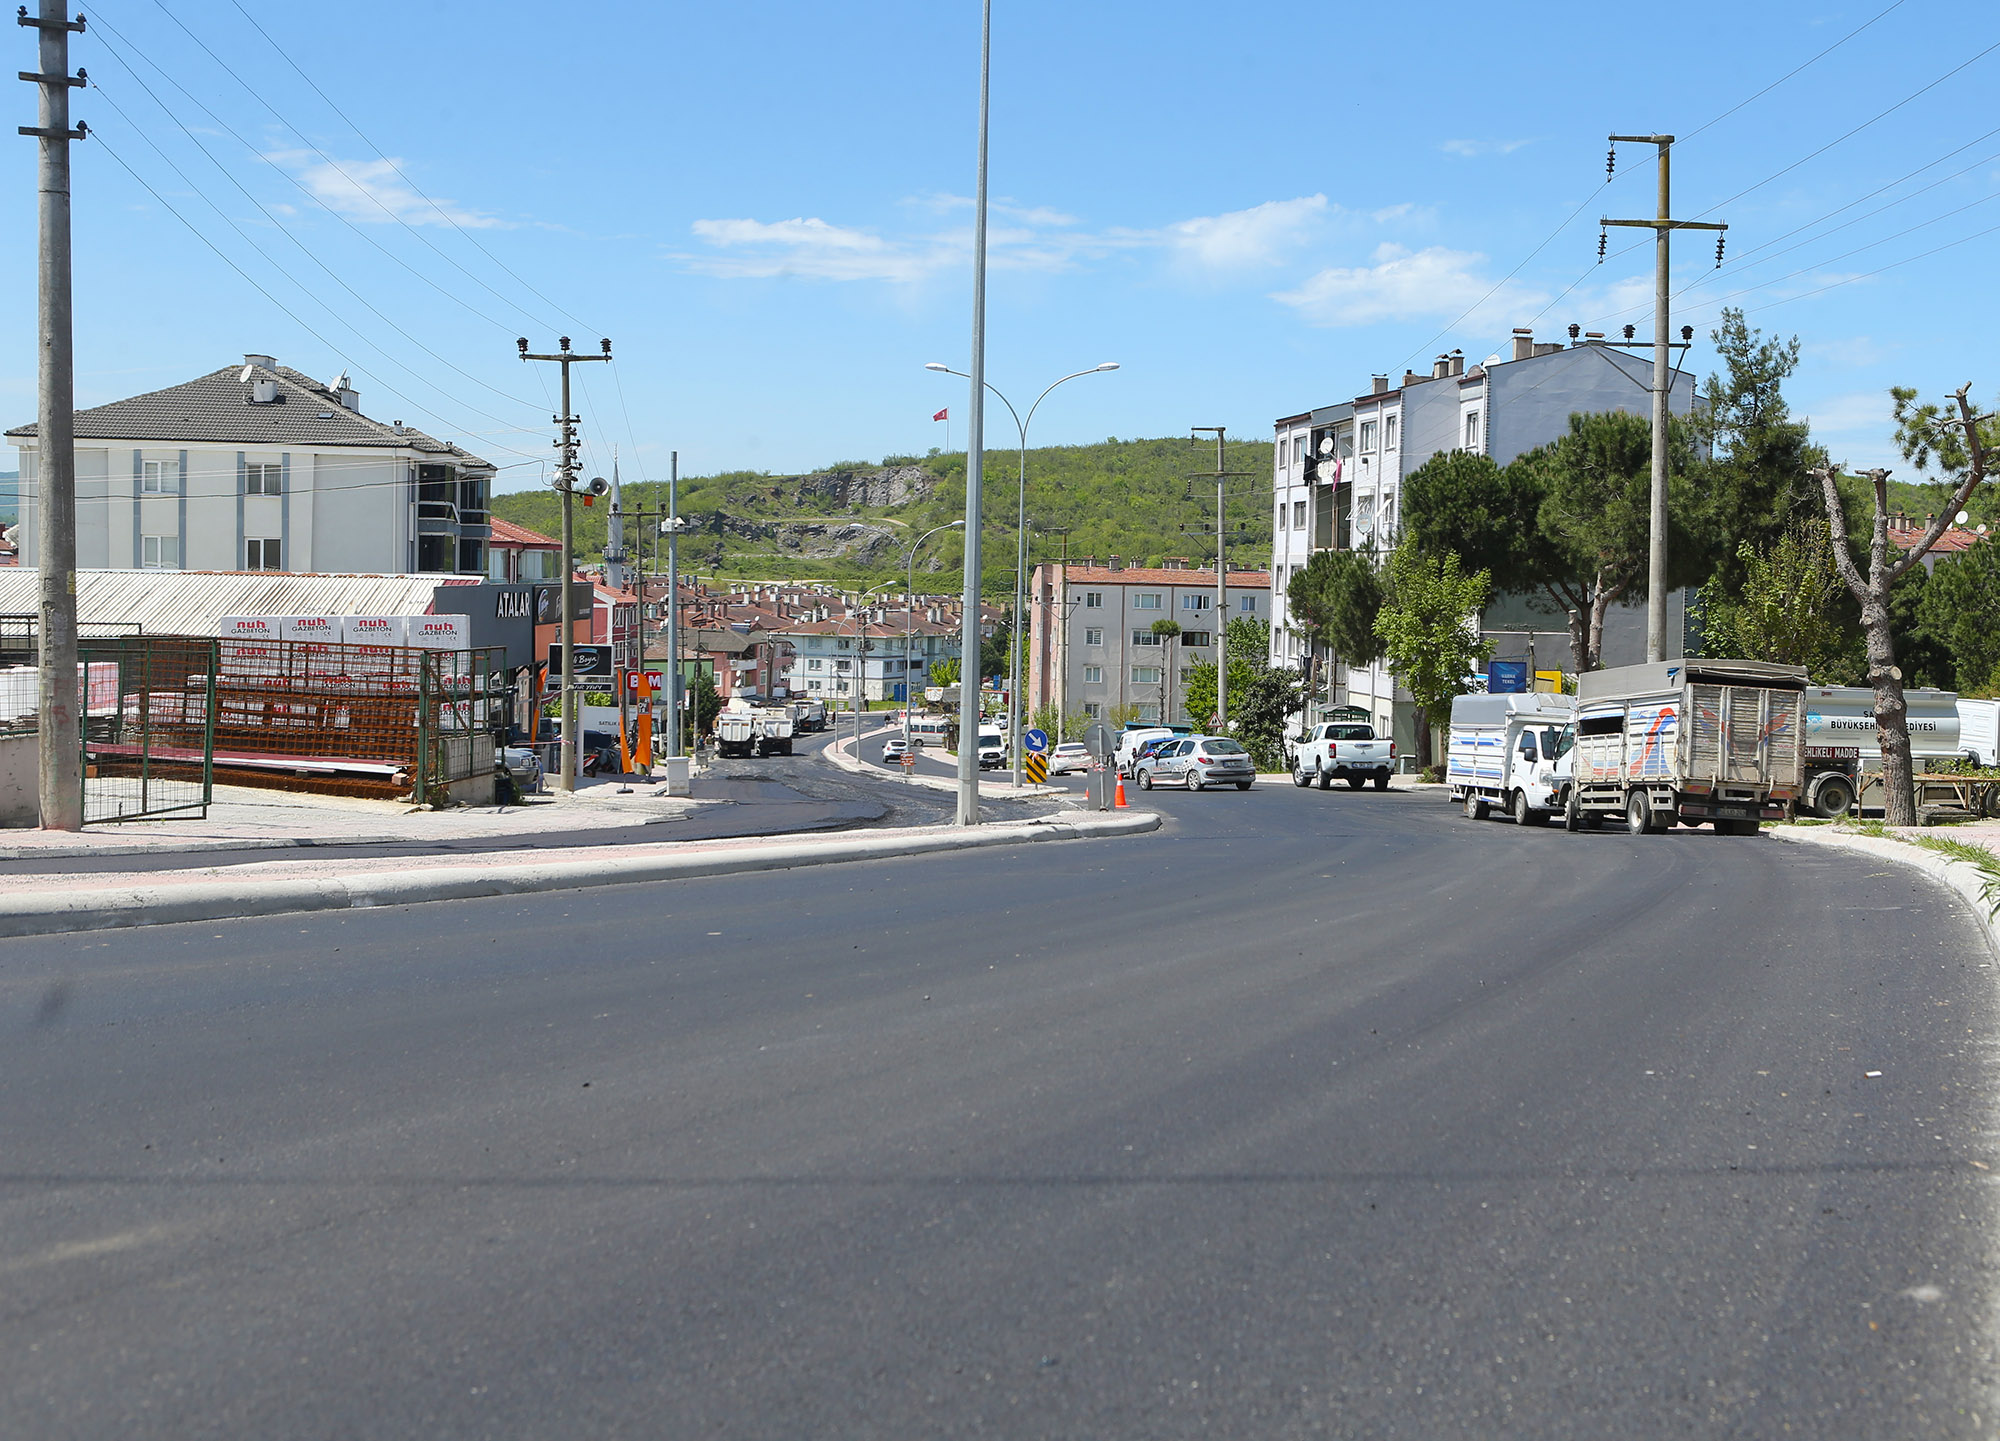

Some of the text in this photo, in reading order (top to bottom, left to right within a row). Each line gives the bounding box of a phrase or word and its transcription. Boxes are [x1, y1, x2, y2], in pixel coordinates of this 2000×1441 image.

[496, 592, 530, 618] ATALAR
[237, 620, 266, 629] nuh
[297, 617, 327, 626] nuh
[358, 618, 388, 627] nuh
[424, 622, 453, 631] nuh
[578, 655, 597, 666] Boya
[630, 675, 661, 688] BM
[1834, 747, 1858, 758] MADDE
